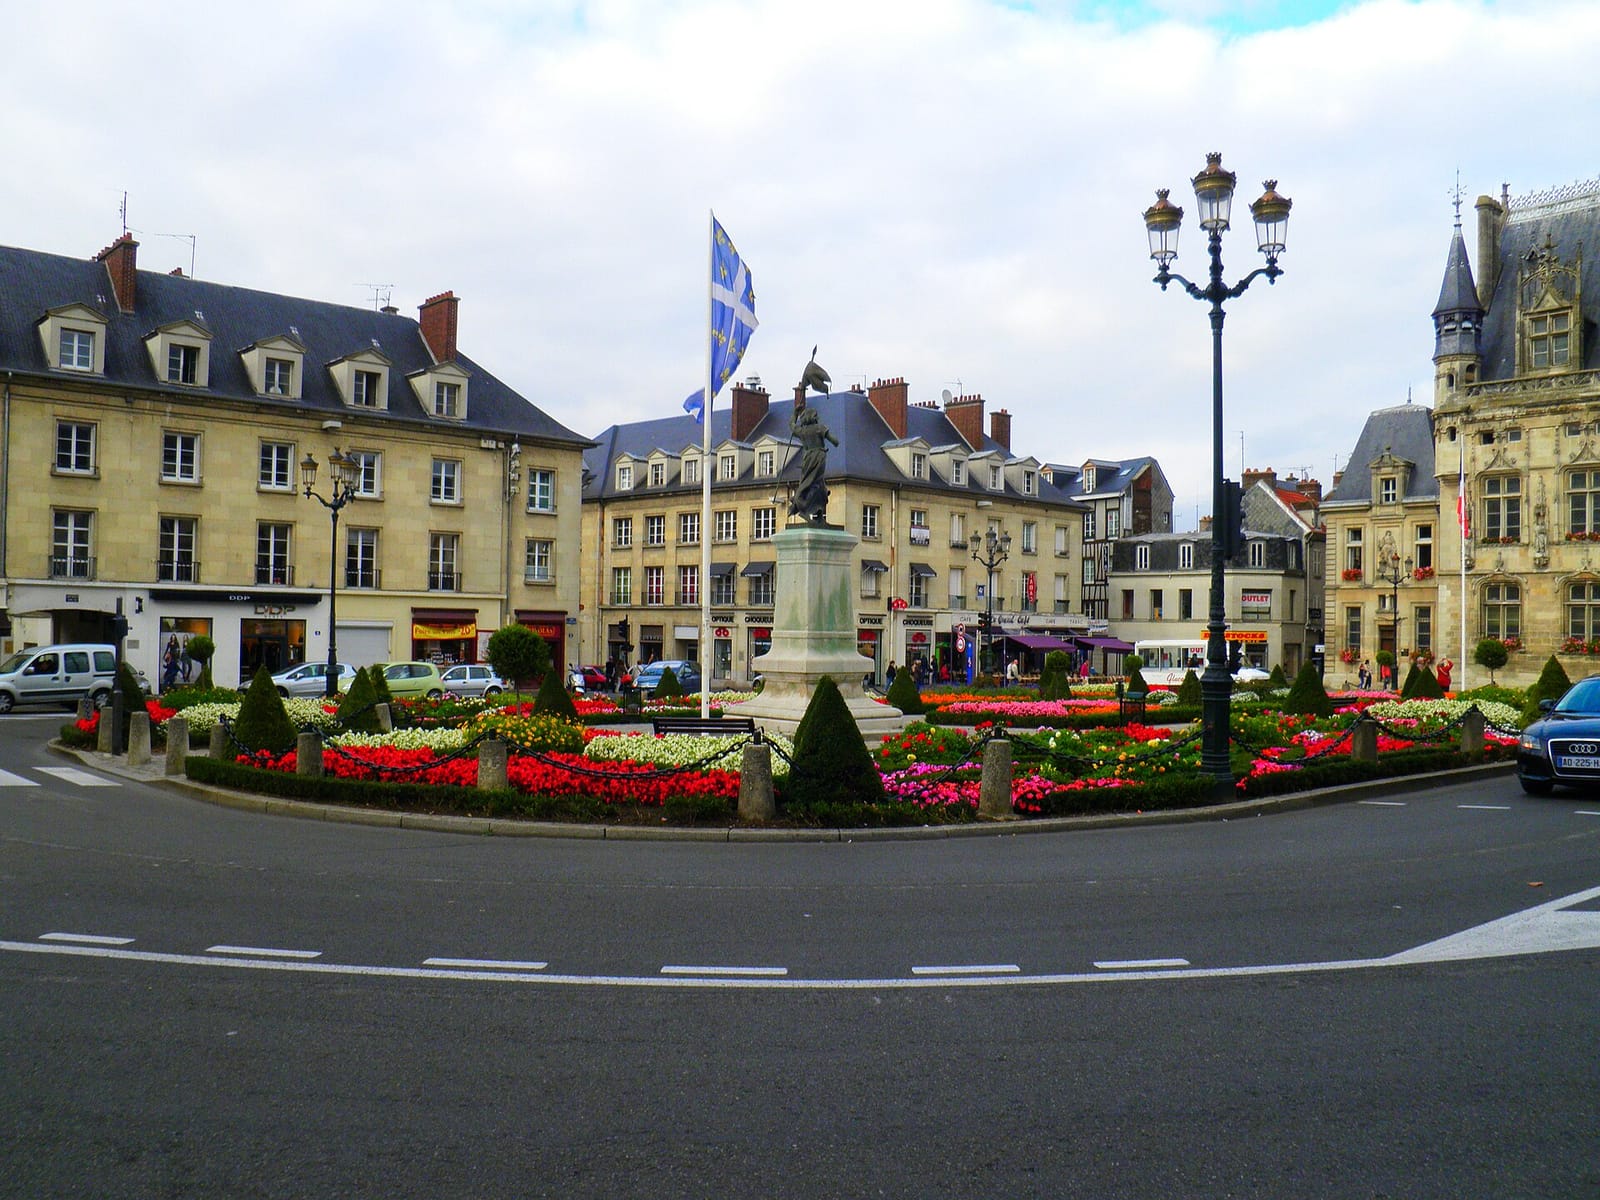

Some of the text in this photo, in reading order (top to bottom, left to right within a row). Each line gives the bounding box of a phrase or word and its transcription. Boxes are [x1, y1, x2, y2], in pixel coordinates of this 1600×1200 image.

[254, 604, 297, 615] DDP
[711, 615, 735, 623] OPTIQUE
[859, 616, 884, 625] OPTIQUE
